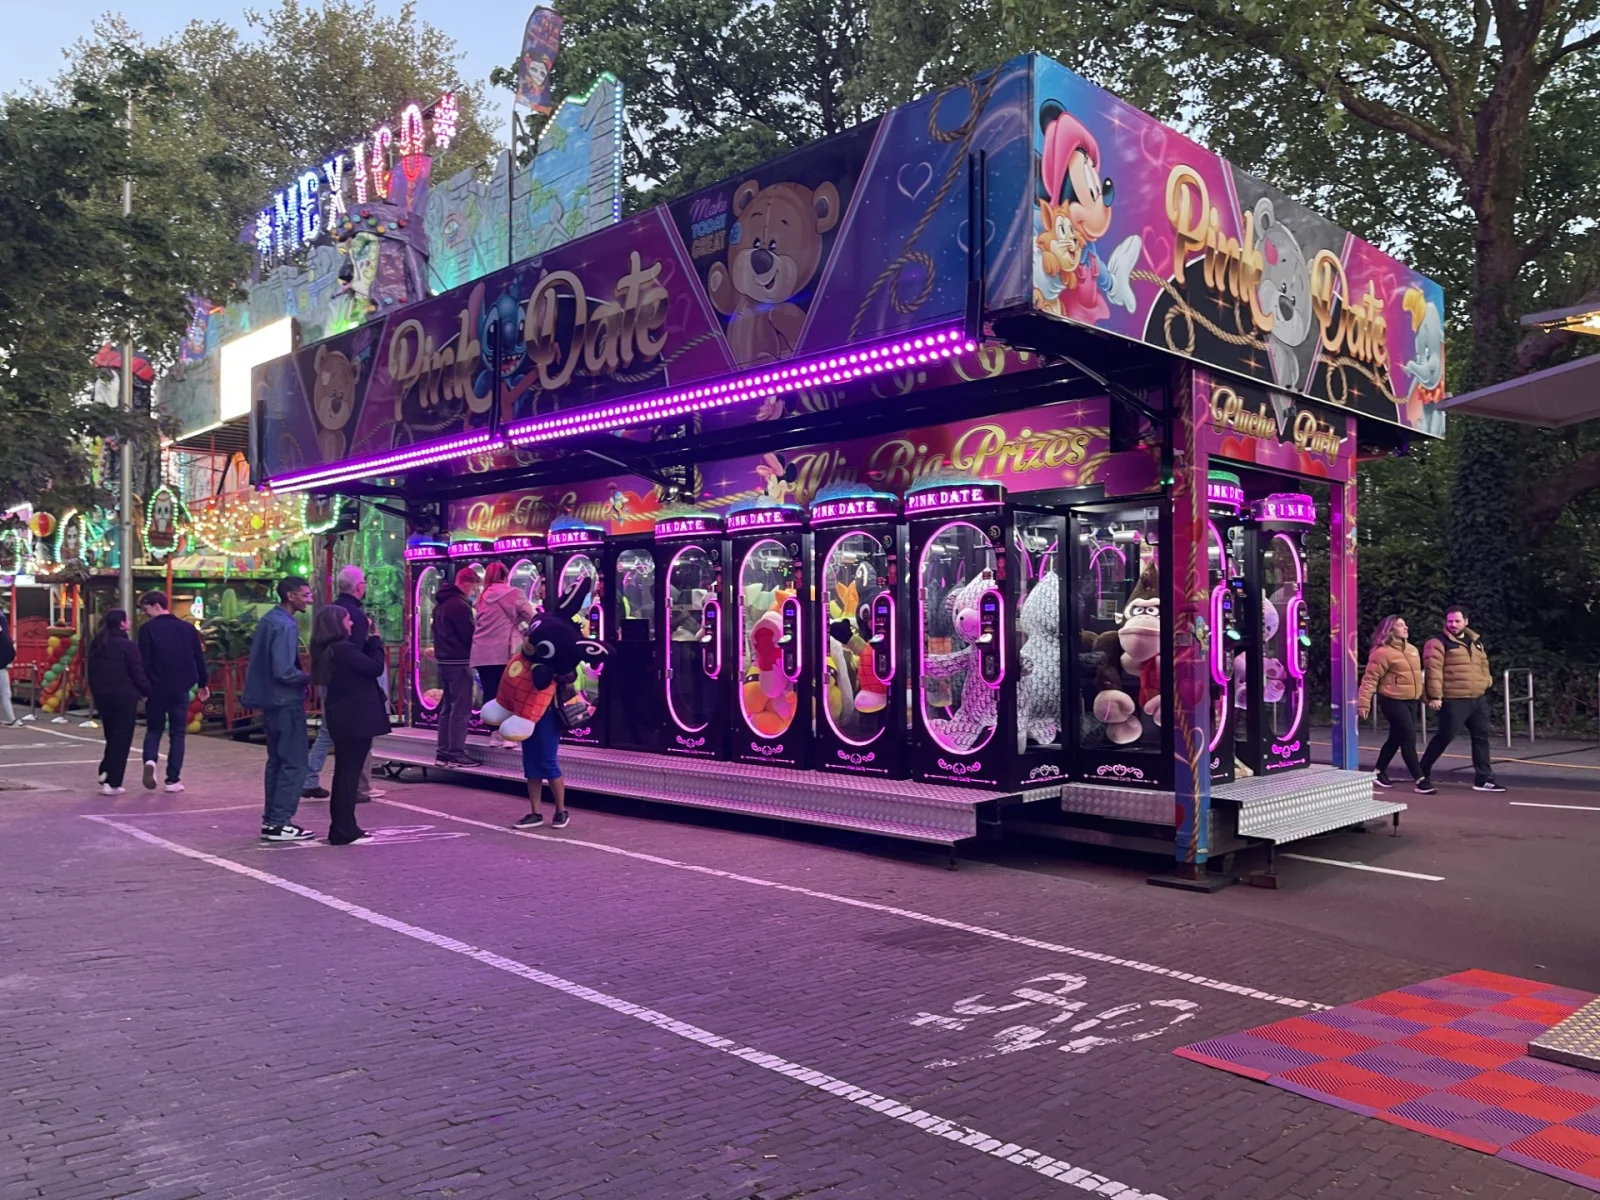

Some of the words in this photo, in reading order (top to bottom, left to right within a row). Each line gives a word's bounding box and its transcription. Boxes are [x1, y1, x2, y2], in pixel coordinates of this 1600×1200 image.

[274, 104, 425, 257] MEXICO
[691, 213, 727, 238] TODAY
[1165, 164, 1275, 334] Pink
[1310, 248, 1388, 368] Date
[388, 308, 493, 421] Pink
[525, 251, 669, 390] Date
[1210, 385, 1277, 440] Pluche
[1293, 409, 1342, 466] Party
[951, 423, 1092, 475] Prizes
[909, 493, 937, 509] PINK
[940, 488, 983, 504] DATE
[1208, 484, 1228, 498] INK
[813, 504, 836, 519] PINK
[838, 500, 876, 514] DATE
[1267, 504, 1305, 517] PINK
[655, 522, 674, 535] PINK
[674, 520, 704, 532] DATE
[727, 514, 748, 528] PINK
[750, 511, 782, 525] DATE
[506, 538, 529, 549] DATE
[562, 531, 587, 542] DATE
[414, 547, 434, 556] DATE
[457, 542, 480, 553] DATE
